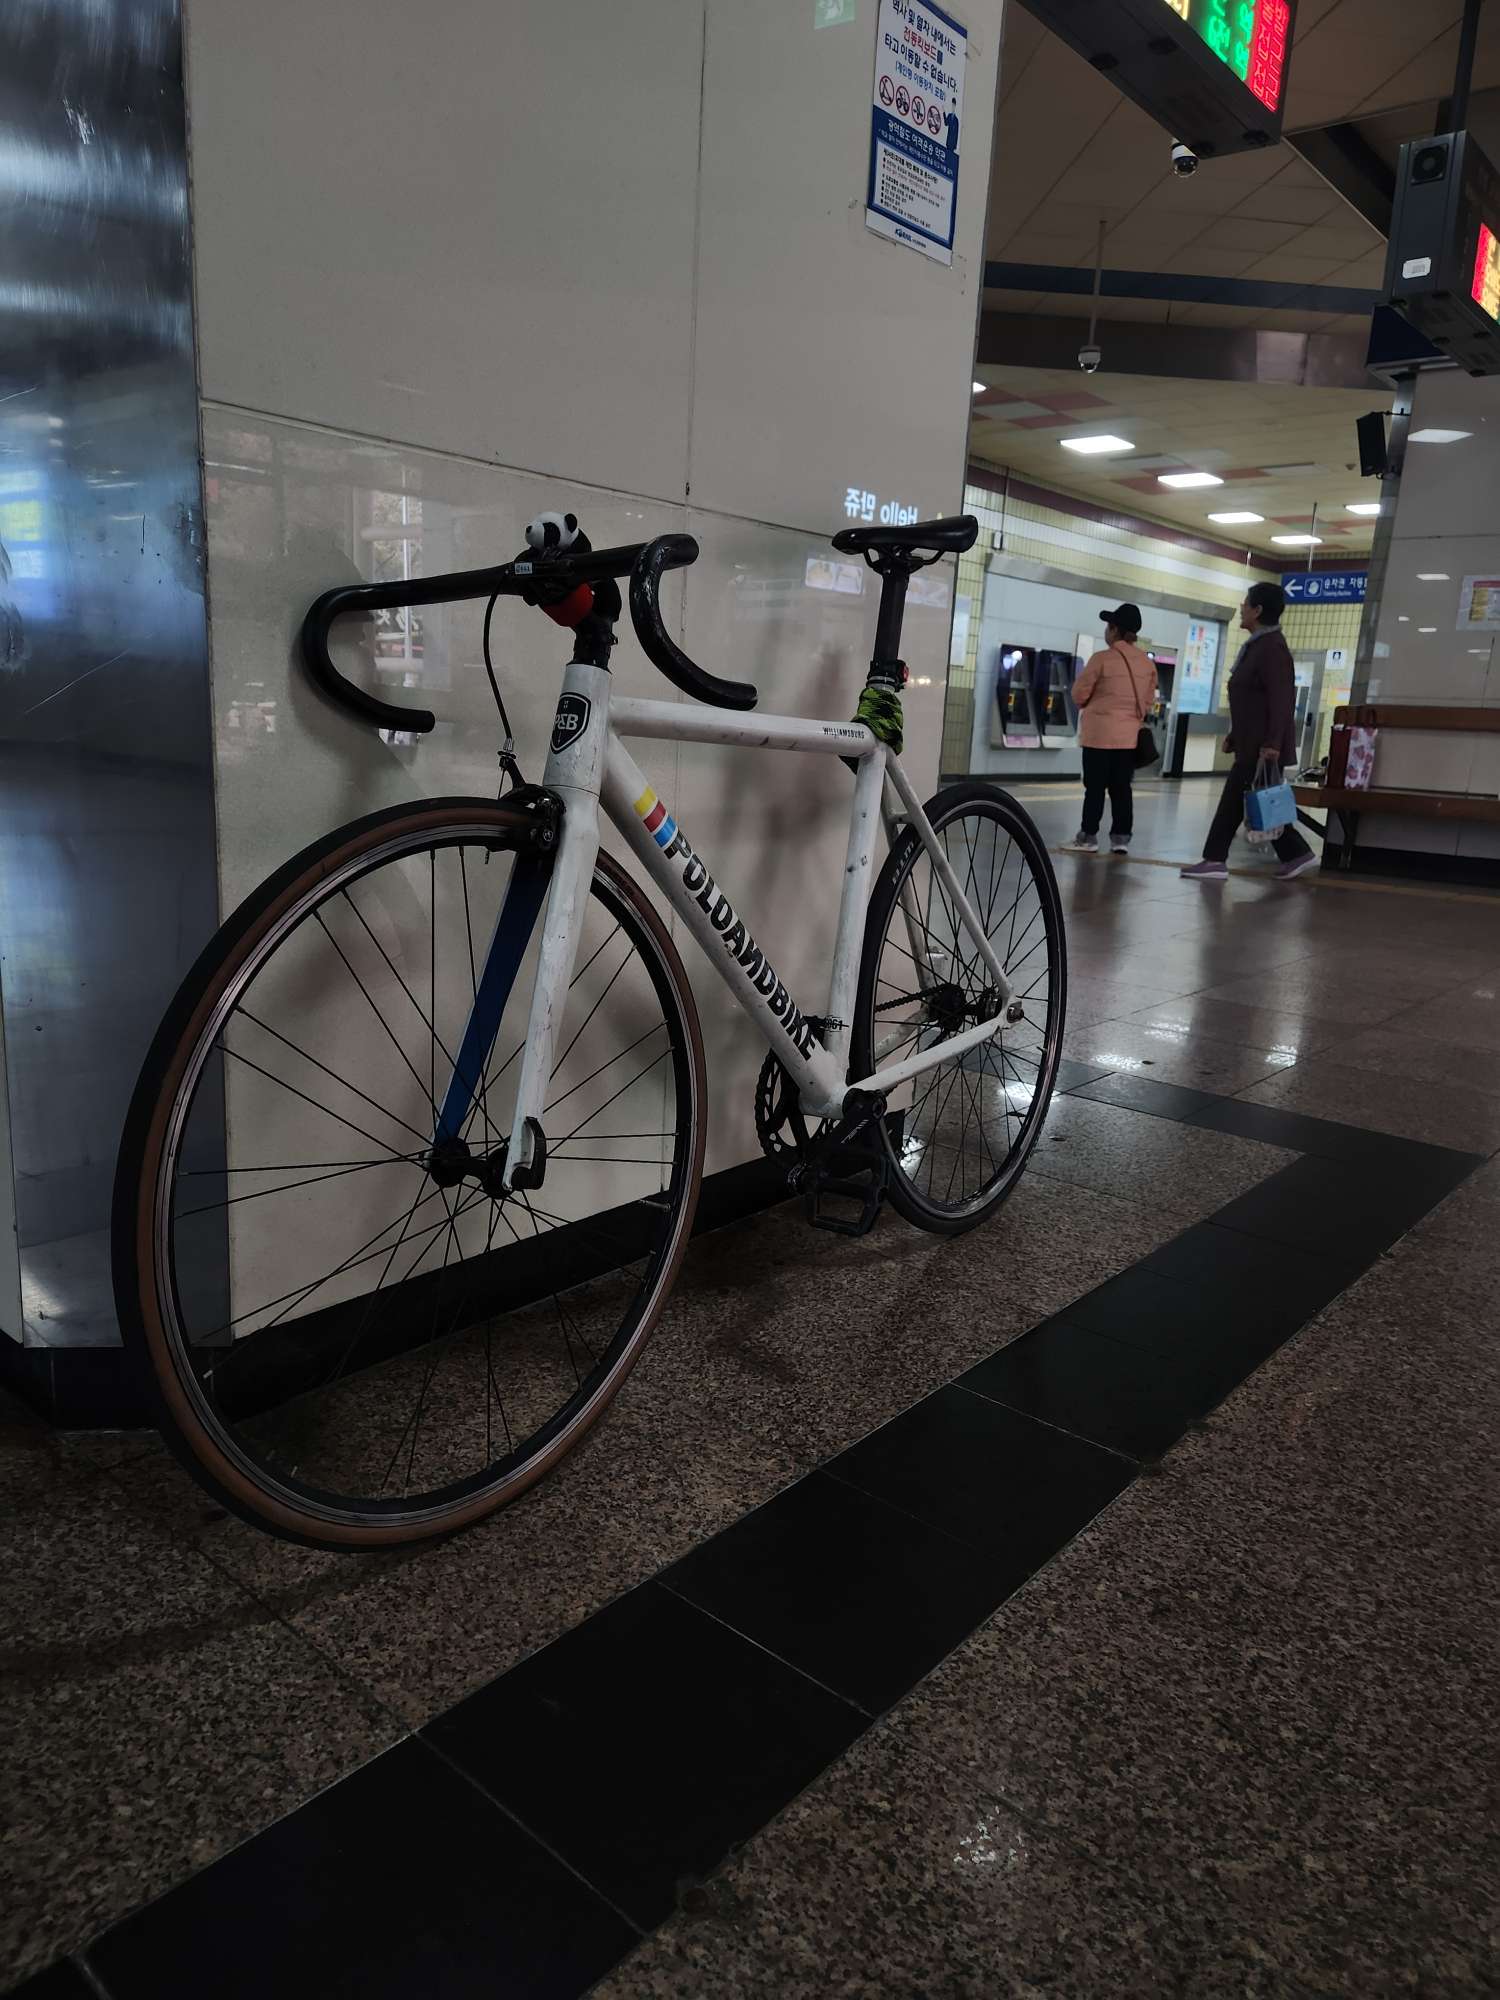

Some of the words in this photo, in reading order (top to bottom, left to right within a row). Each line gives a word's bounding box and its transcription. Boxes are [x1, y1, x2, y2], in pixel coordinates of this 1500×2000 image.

[892, 0, 908, 19] 역사
[908, 9, 916, 26] 및
[931, 27, 956, 56] 내에서는
[903, 26, 944, 66] 전동킥보드를
[884, 33, 899, 54] 타고
[900, 44, 921, 69] 이동할
[922, 60, 930, 74] 수
[930, 63, 958, 93] 없습니다.
[664, 829, 817, 1061] POLOANDBIKE
